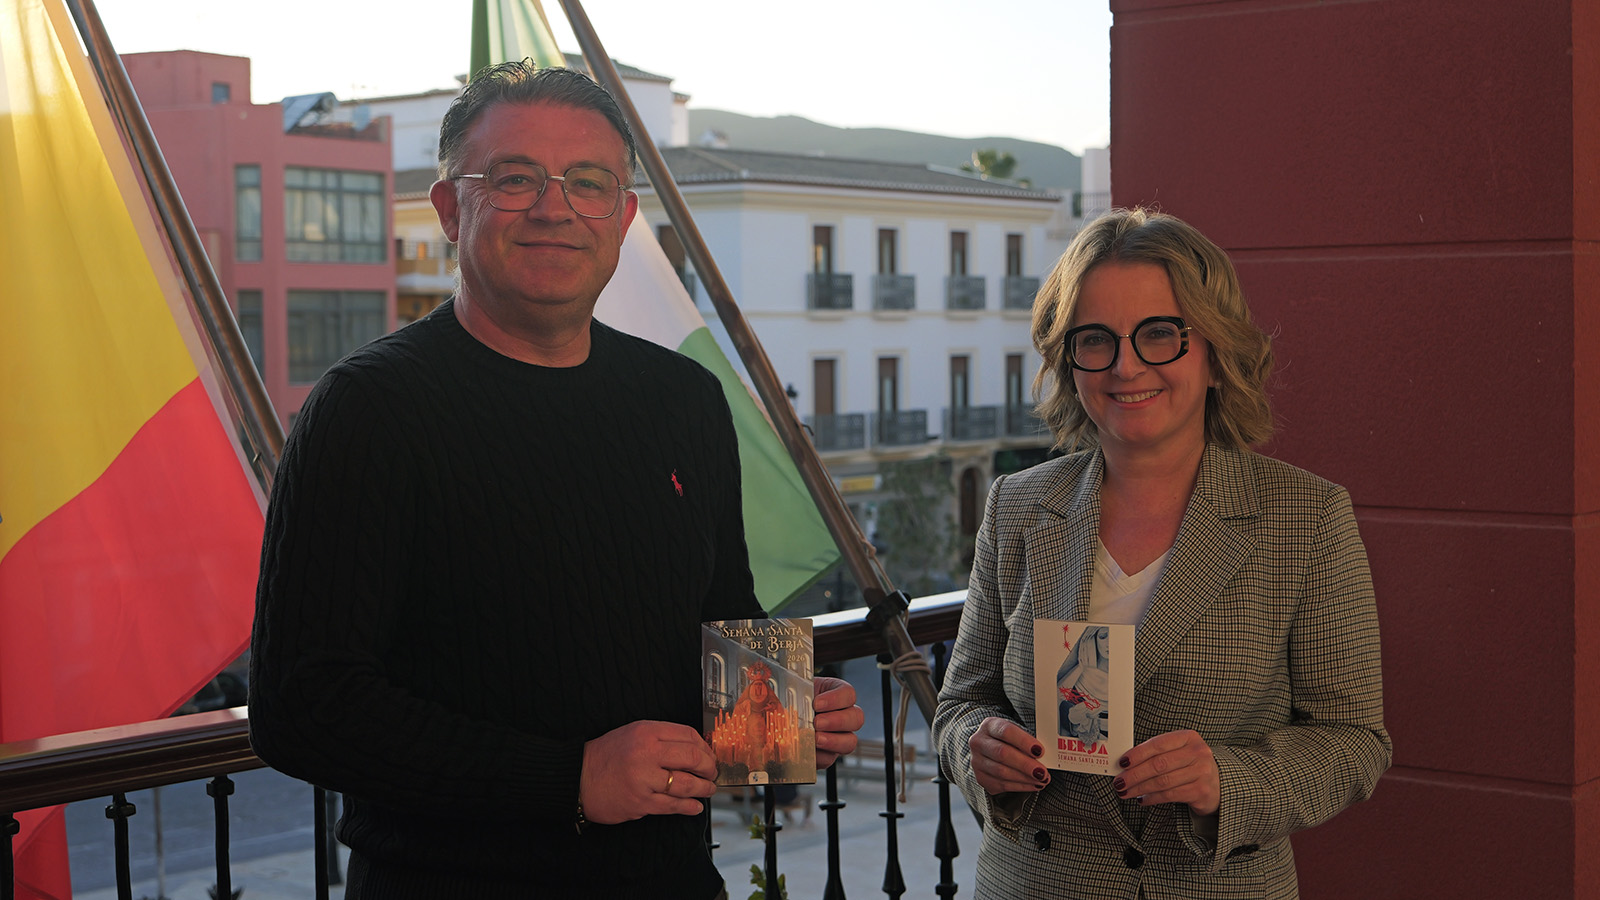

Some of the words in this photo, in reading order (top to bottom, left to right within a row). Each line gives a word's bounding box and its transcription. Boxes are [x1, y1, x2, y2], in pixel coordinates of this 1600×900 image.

[722, 625, 764, 638] SEMANA
[769, 624, 804, 636] SANTA
[750, 641, 763, 650] DE
[768, 636, 804, 652] BERJA
[1058, 738, 1108, 755] BERJA
[1078, 756, 1094, 764] SANTA
